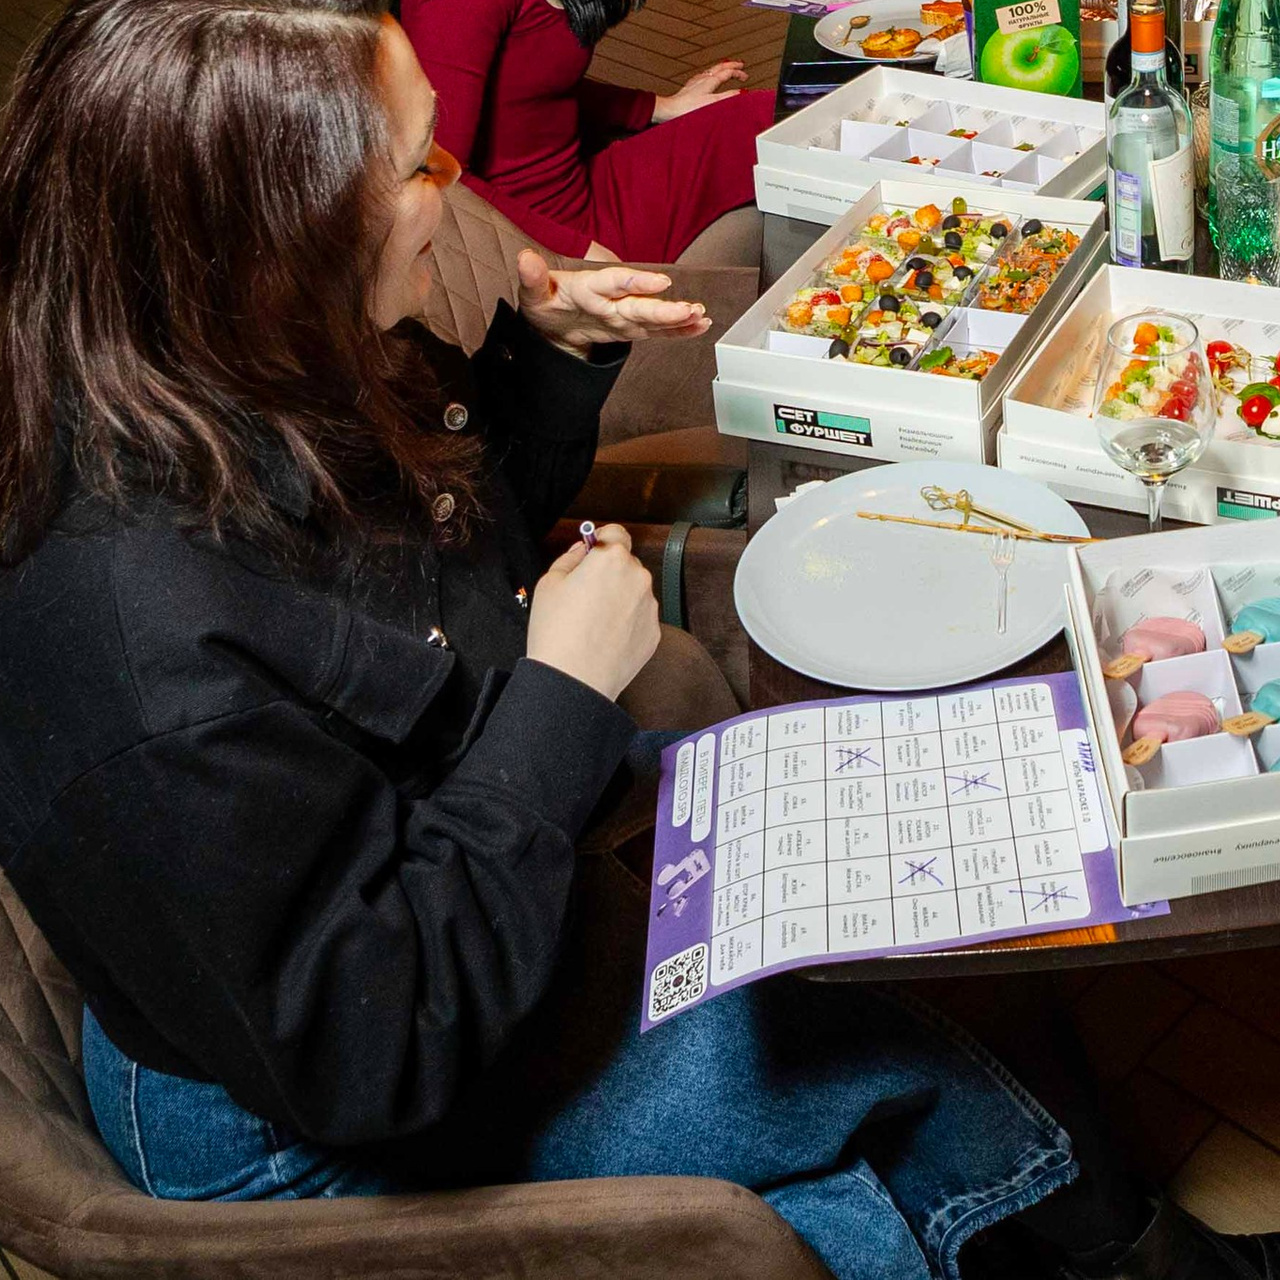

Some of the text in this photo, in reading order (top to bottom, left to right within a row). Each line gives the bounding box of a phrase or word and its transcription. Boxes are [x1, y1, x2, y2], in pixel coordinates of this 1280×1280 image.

[1008, 1, 1046, 18] 100%
[1008, 11, 1050, 25] НАТУРАЛЬНЫЕ
[1018, 20, 1043, 30] ФРУКТЫ
[778, 407, 814, 423] СЕТ
[789, 422, 867, 445] ФУРШЕТ
[697, 759, 708, 794] ПИТЕРЕ
[1076, 779, 1089, 811] КАРАОКЕ
[1153, 847, 1222, 863] #нановоселье
